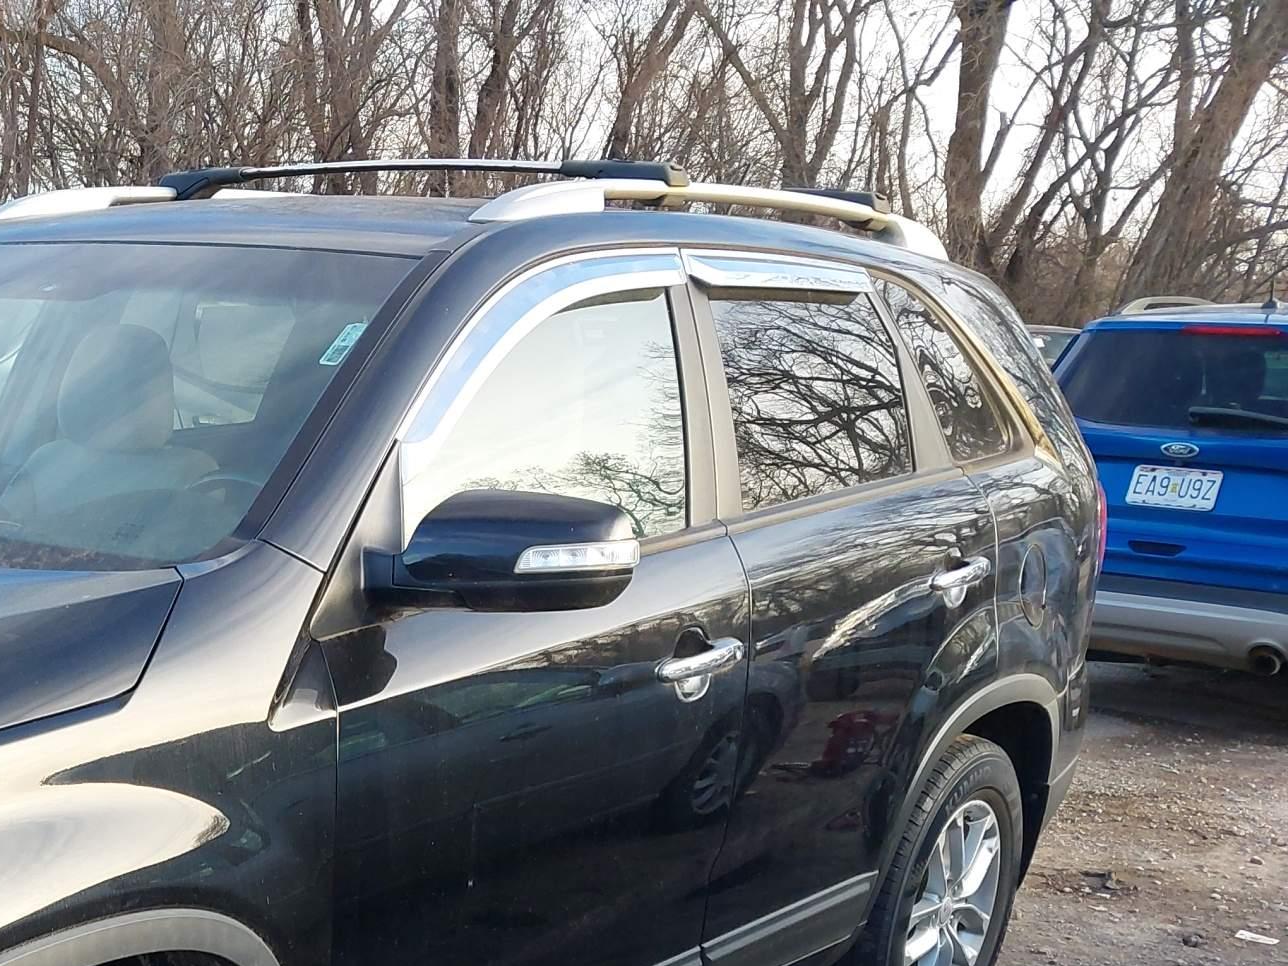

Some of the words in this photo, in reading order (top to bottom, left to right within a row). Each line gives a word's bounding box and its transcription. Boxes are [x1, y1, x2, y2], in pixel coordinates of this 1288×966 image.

[1166, 444, 1192, 455] Ford
[1132, 473, 1171, 497] EA9
[1177, 477, 1217, 501] U9Z
